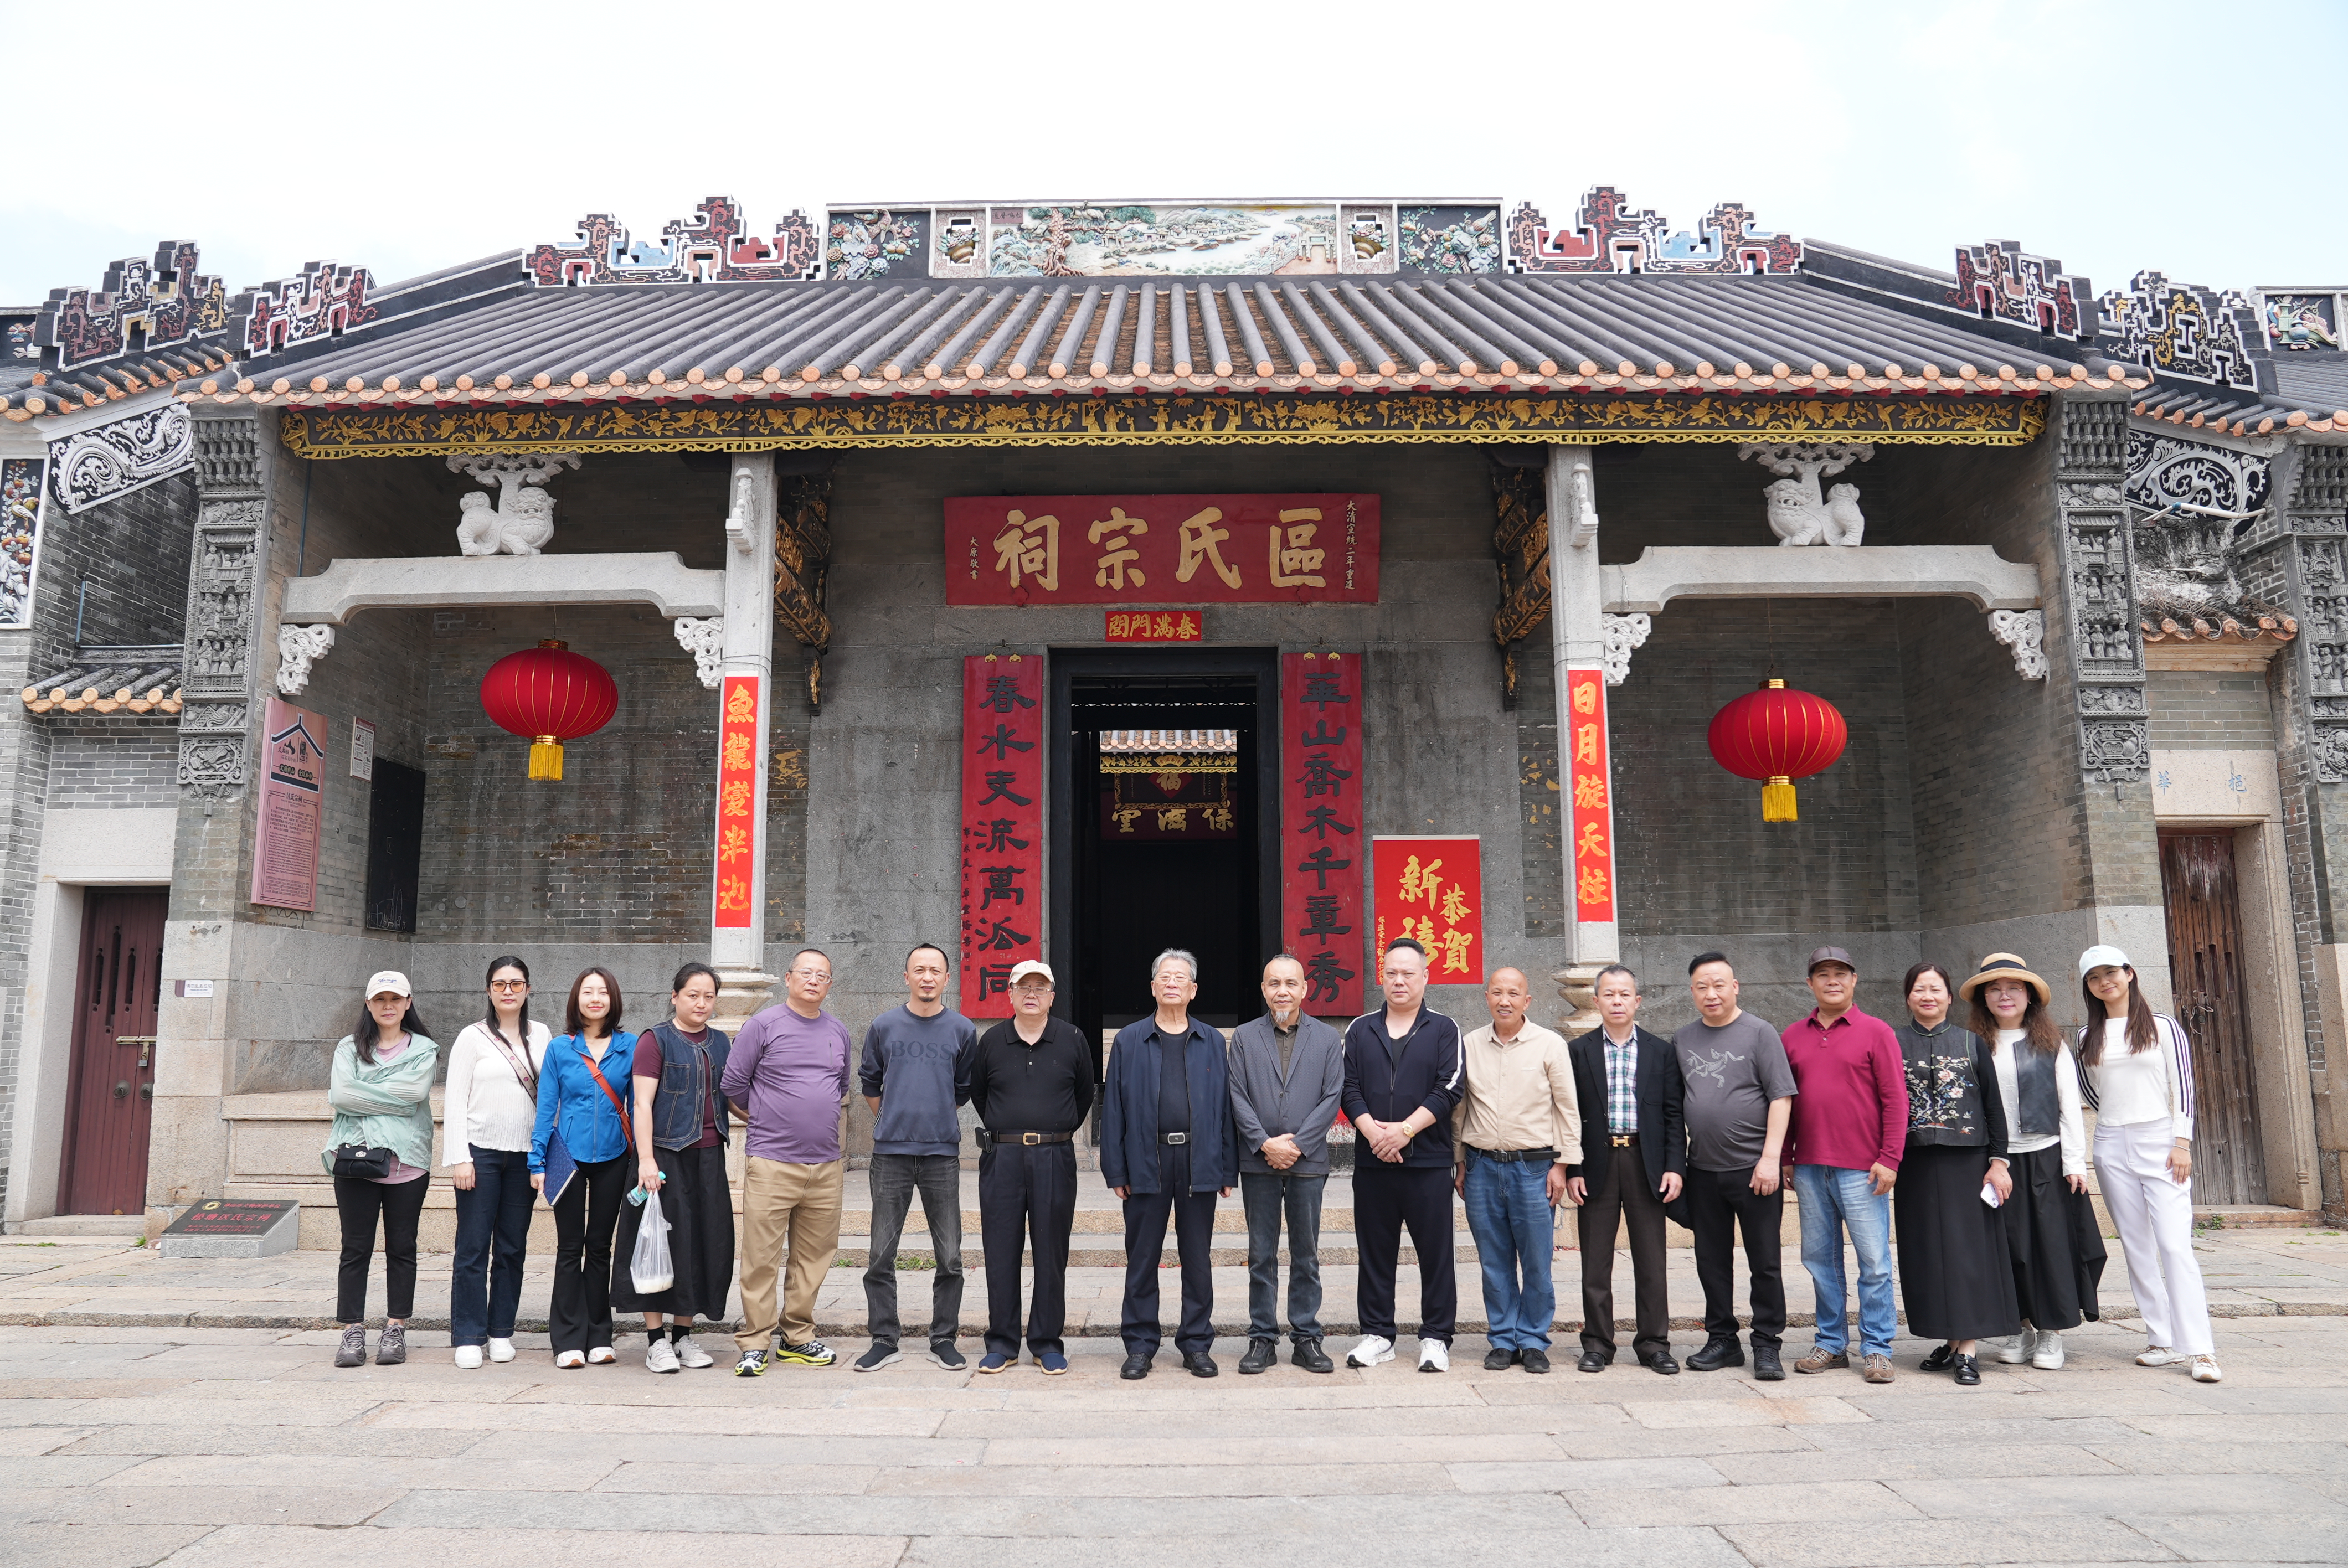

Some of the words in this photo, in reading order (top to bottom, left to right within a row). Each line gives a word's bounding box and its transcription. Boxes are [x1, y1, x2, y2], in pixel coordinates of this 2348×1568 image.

[993, 507, 1326, 591] 區氏宗祠
[1156, 772, 1182, 791] 福
[1573, 681, 1609, 905] 日月旋天柱
[1394, 855, 1444, 967] 新禧
[1439, 883, 1474, 975] 恭賀
[891, 1040, 952, 1060] BOSS
